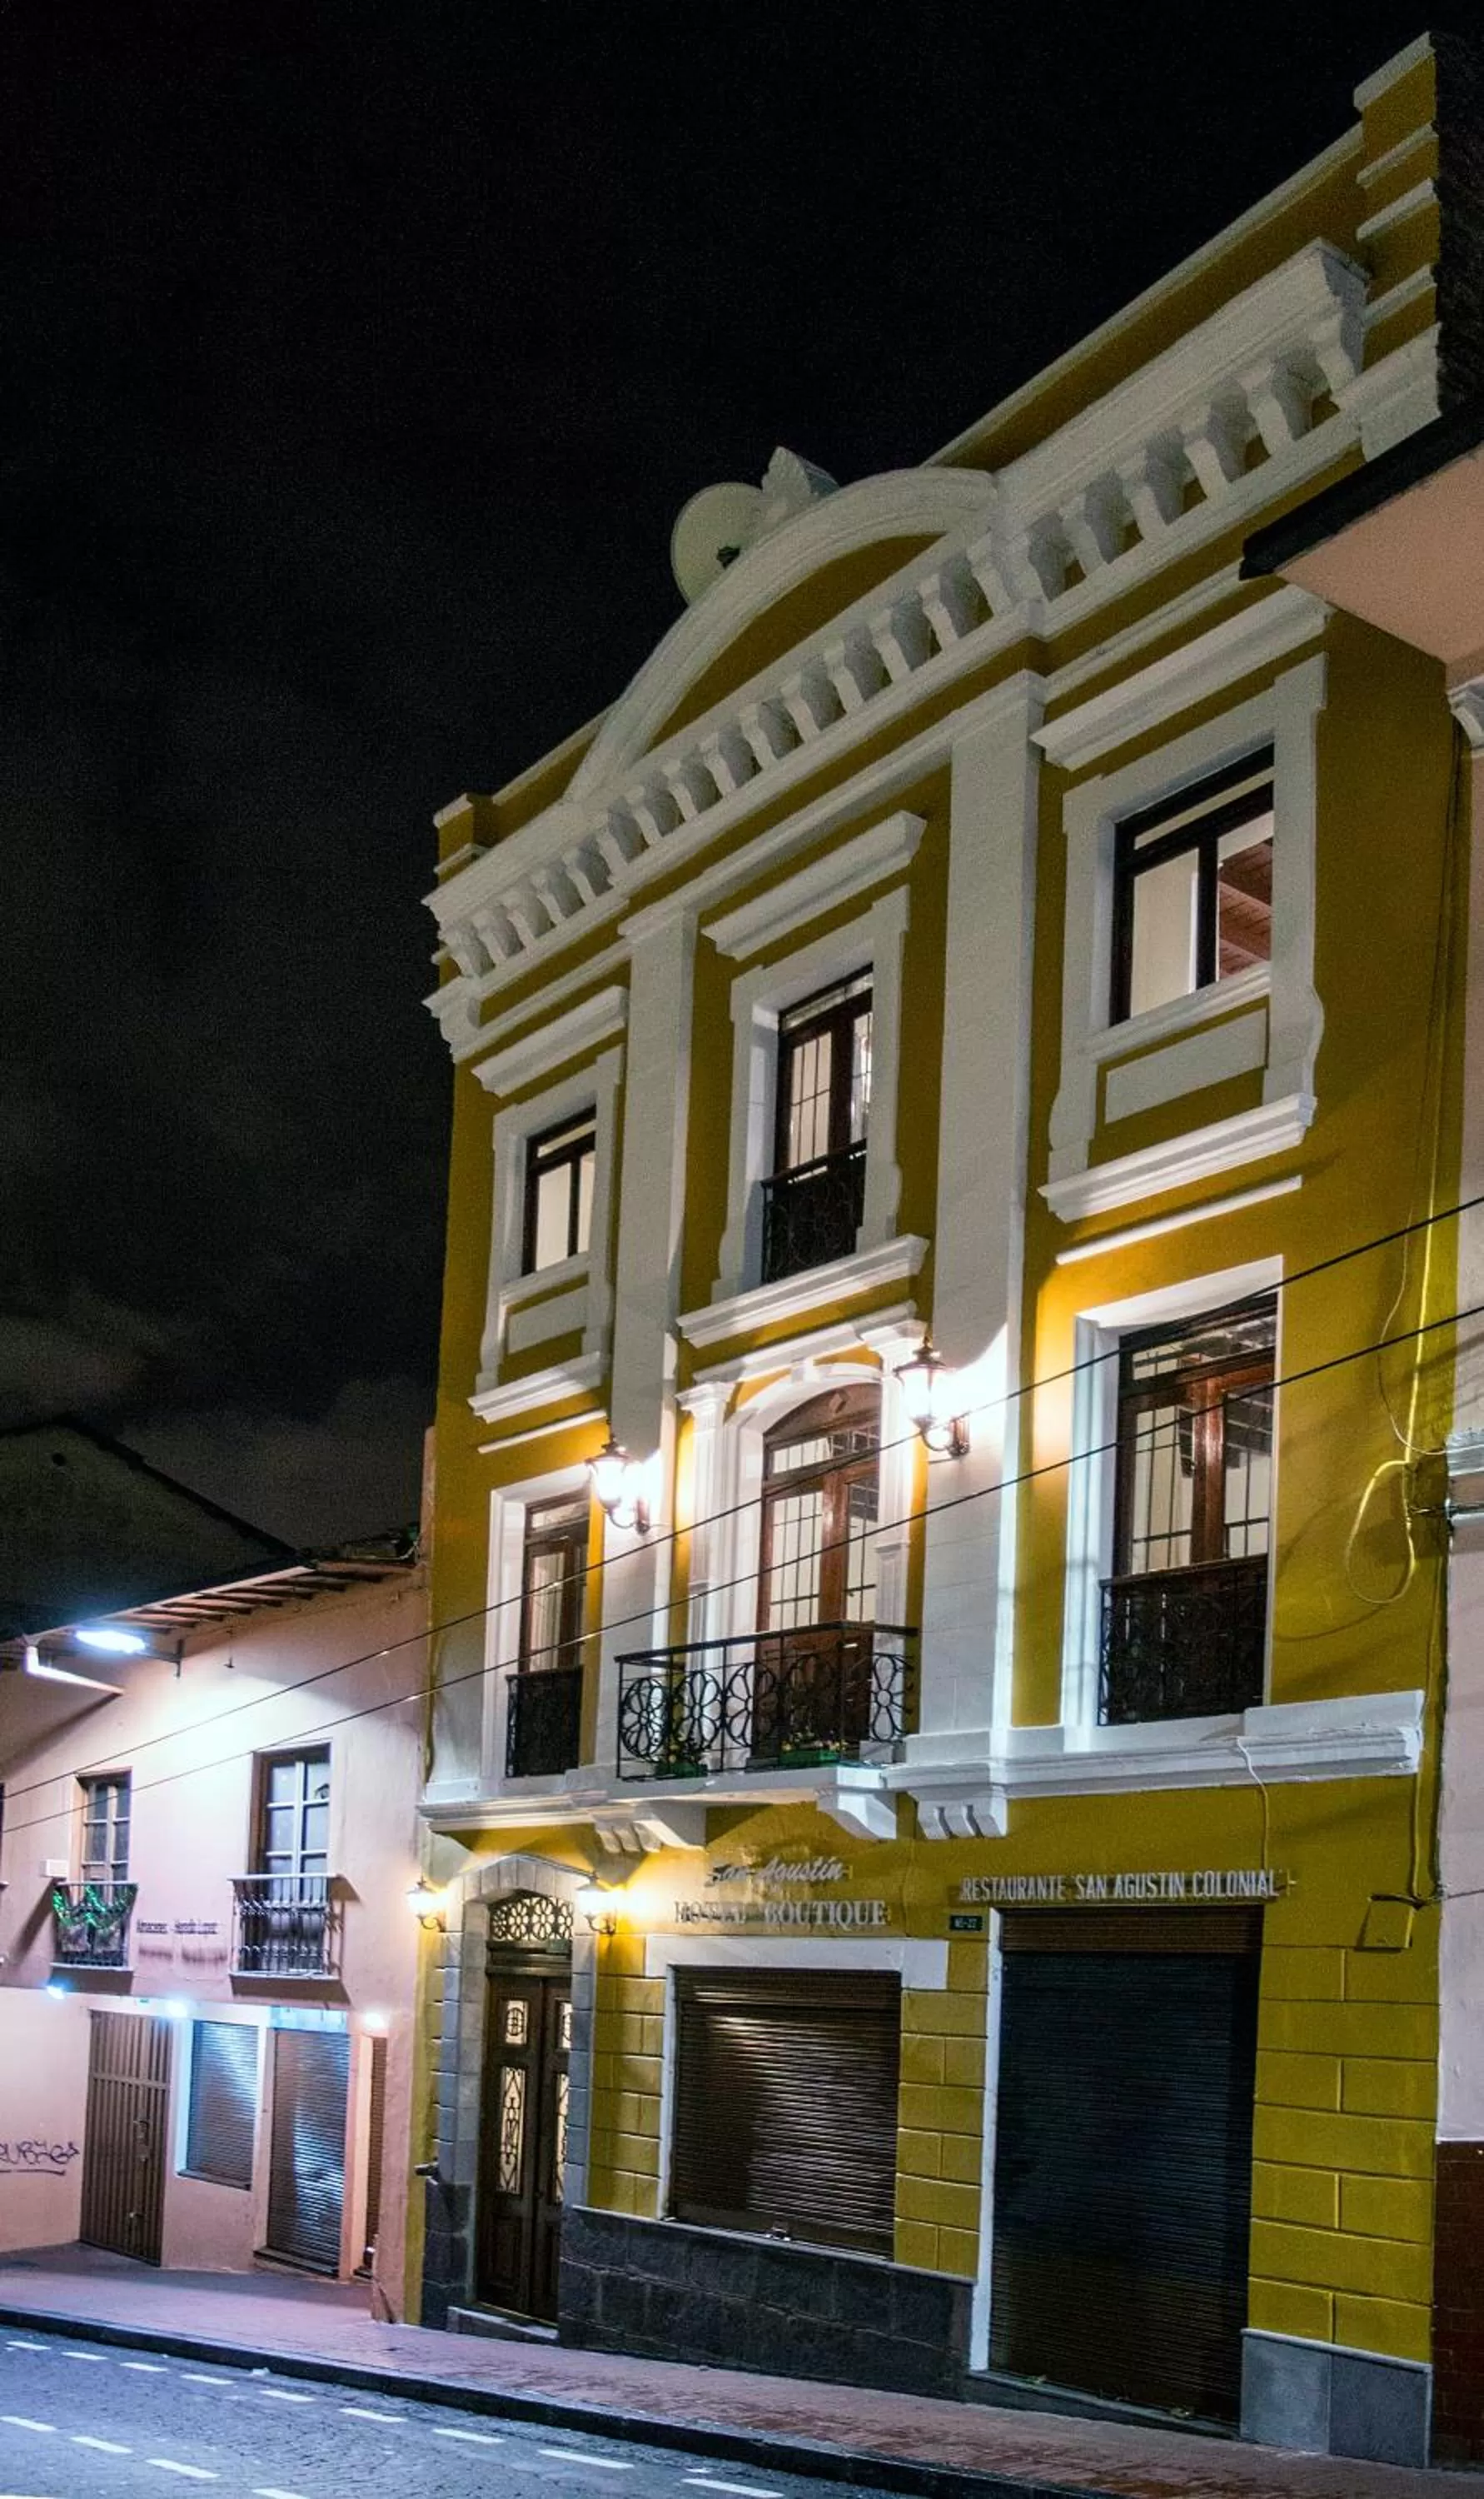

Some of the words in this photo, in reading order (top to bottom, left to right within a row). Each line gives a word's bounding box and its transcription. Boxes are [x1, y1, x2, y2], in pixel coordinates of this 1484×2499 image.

[960, 1875, 1066, 1902] RESTAURANTE
[1074, 1873, 1108, 1900] SAN
[1113, 1871, 1186, 1899] AGUSTIN
[1191, 1868, 1280, 1898] COLONIAL
[764, 1900, 886, 1932] BOUTIQUE
